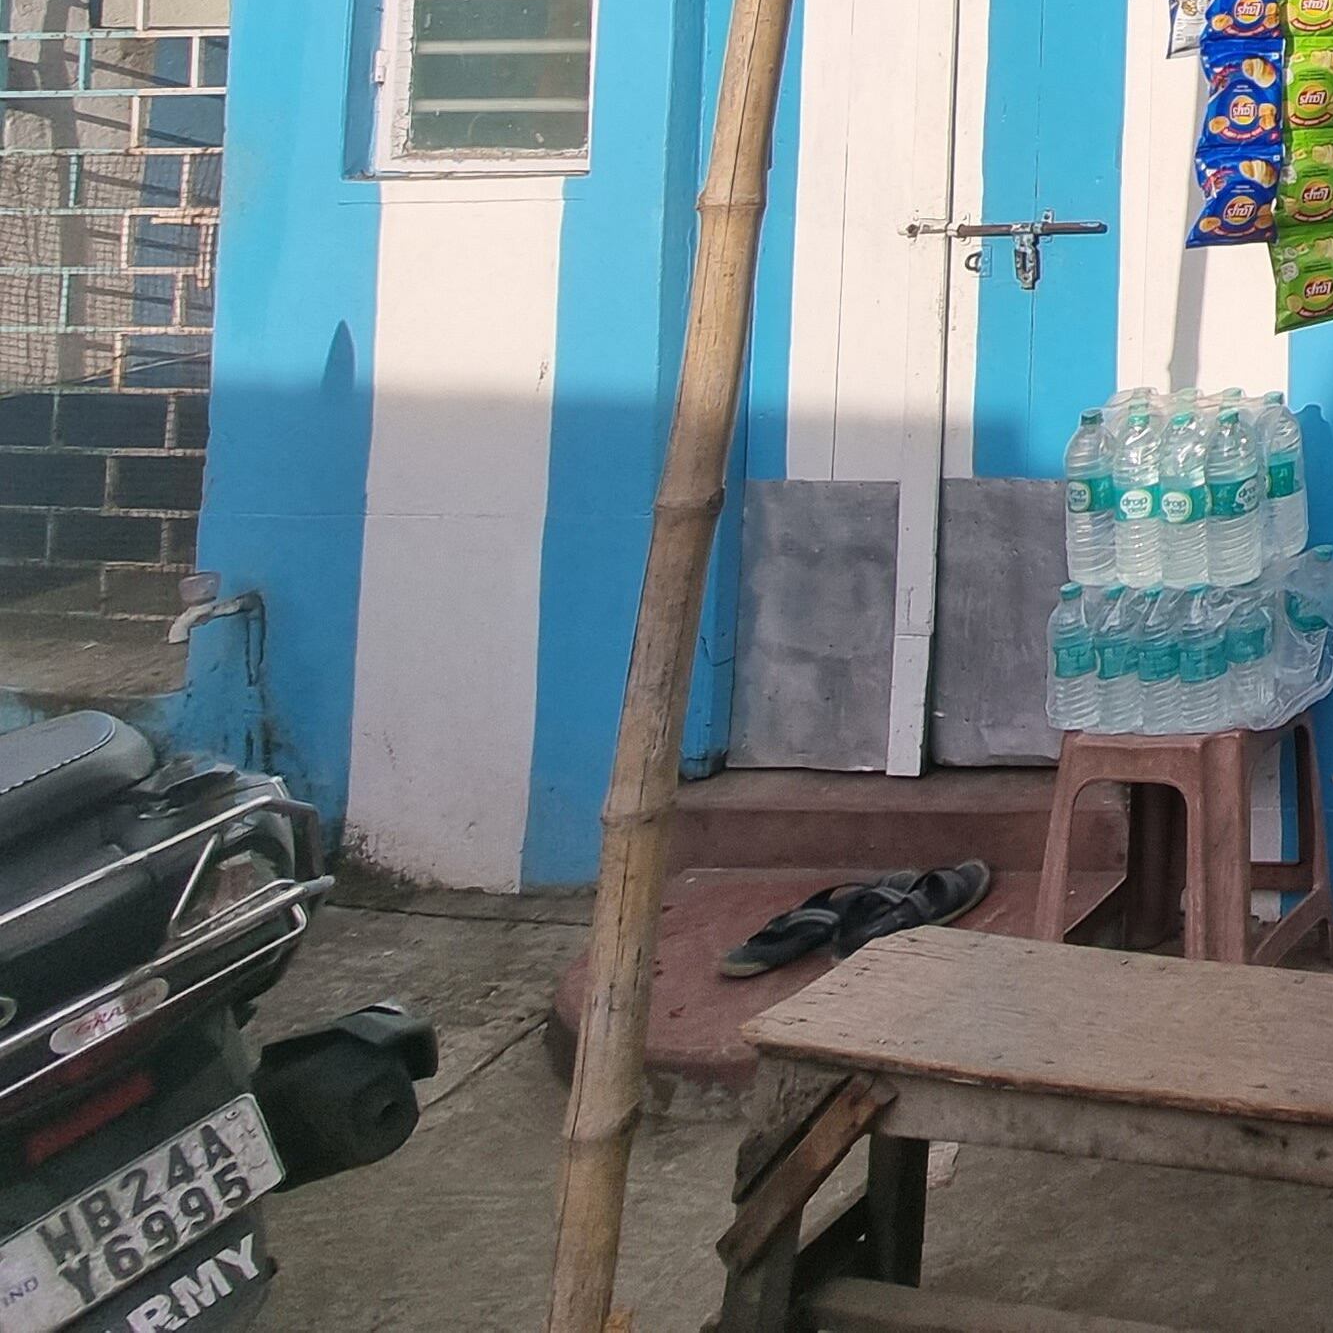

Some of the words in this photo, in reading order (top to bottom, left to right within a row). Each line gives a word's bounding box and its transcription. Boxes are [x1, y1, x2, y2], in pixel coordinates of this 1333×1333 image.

[37, 1123, 234, 1266] WB24A
[58, 1162, 251, 1305] Y6995
[105, 1233, 260, 1333] RMY
